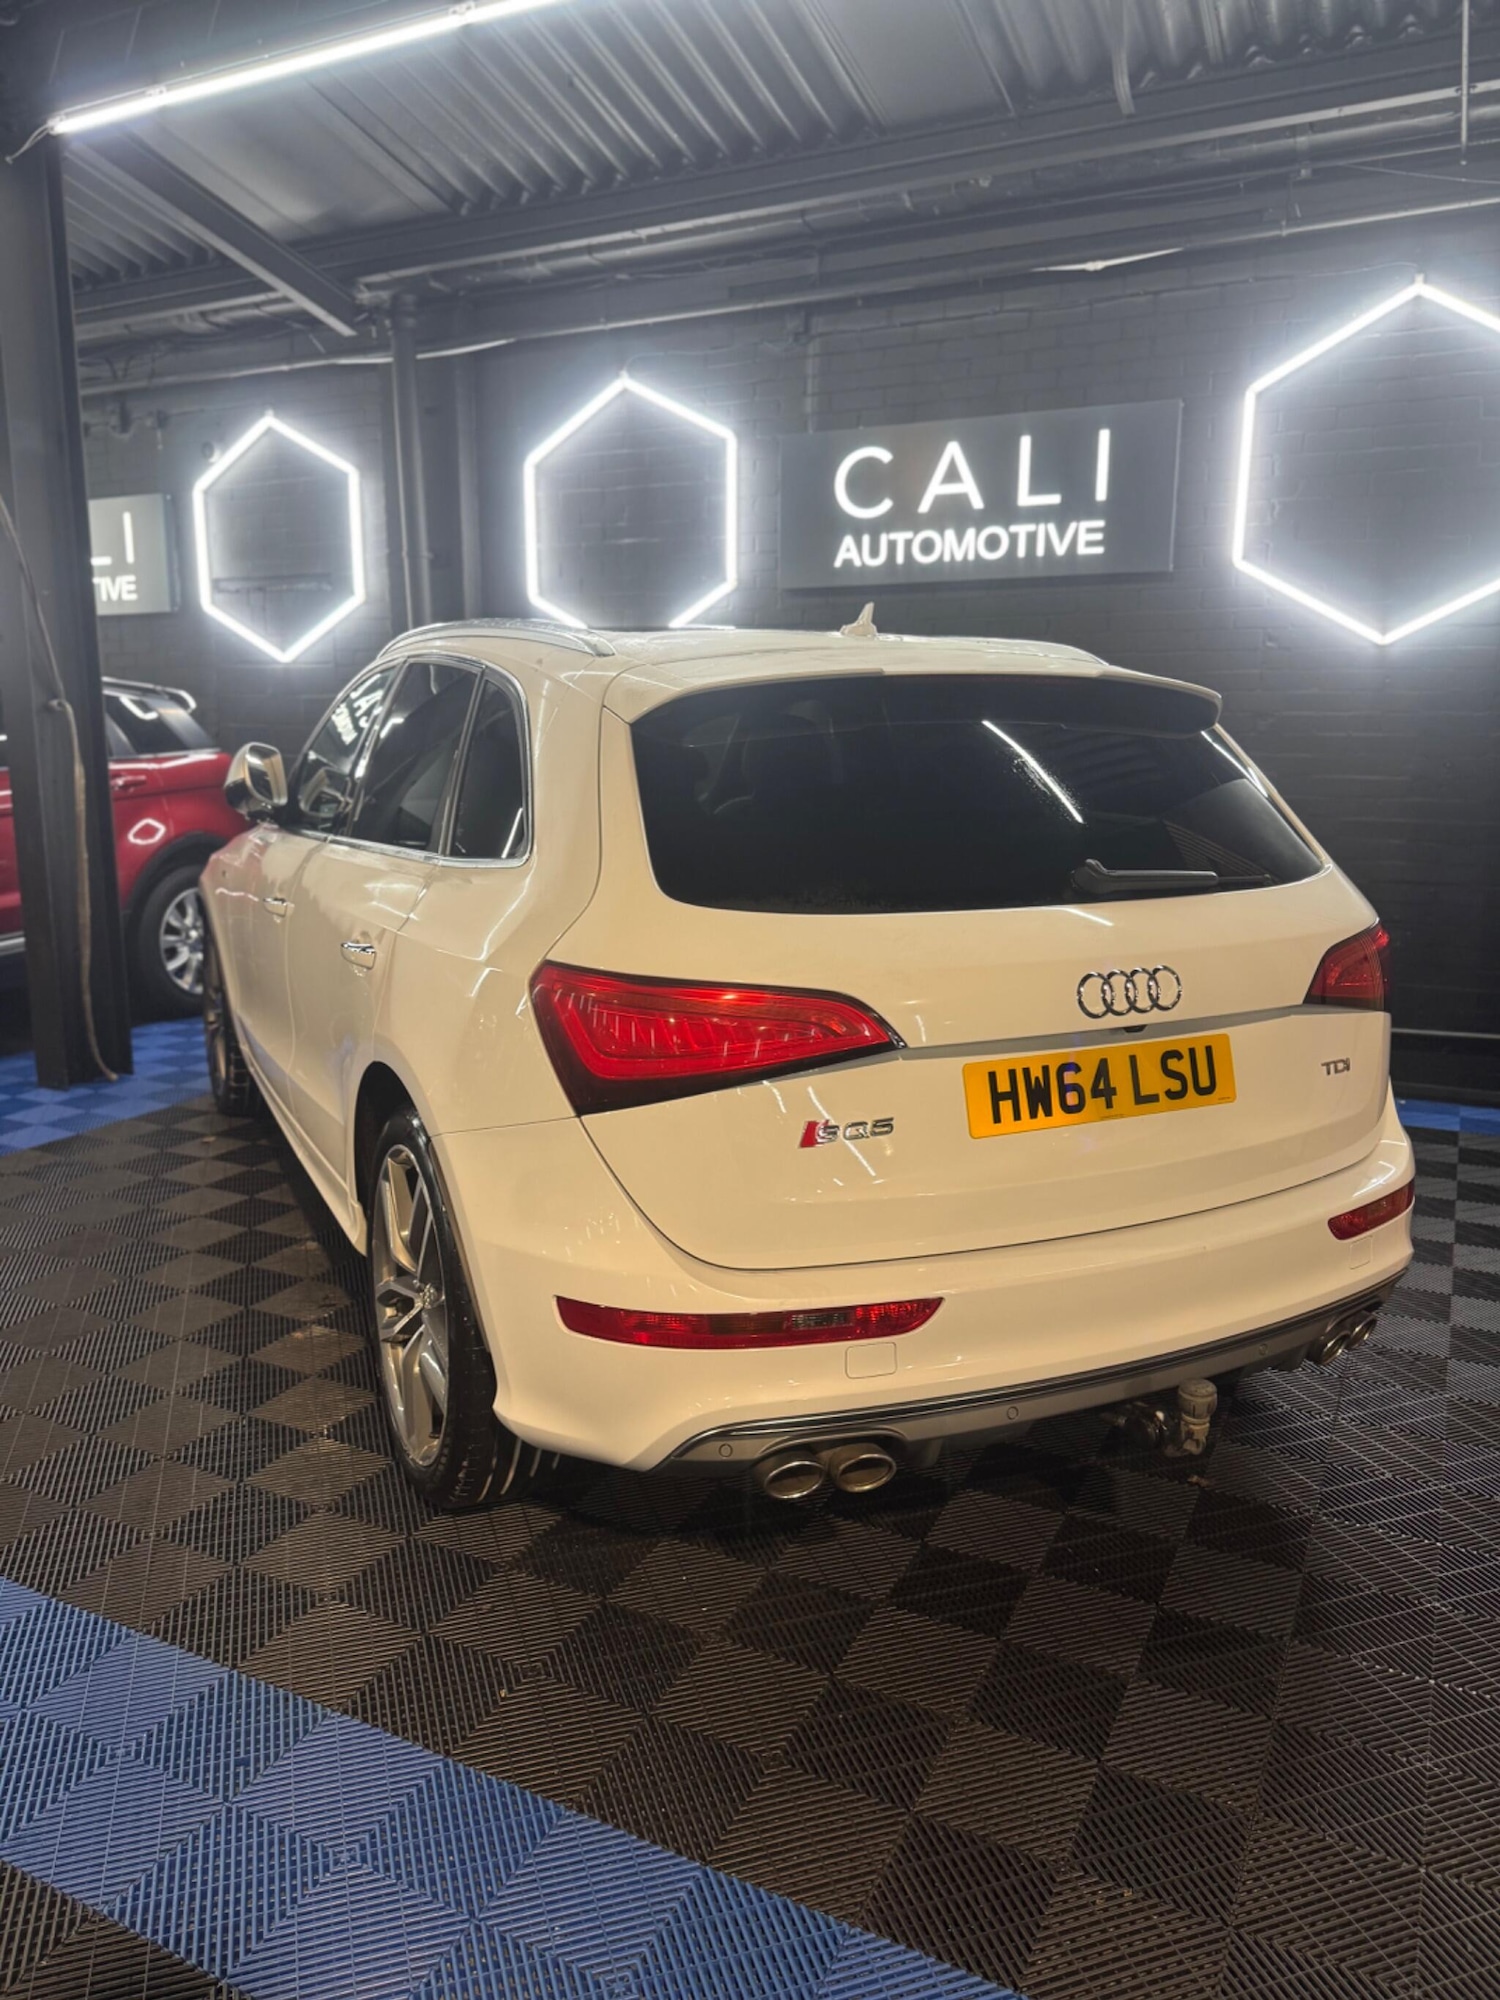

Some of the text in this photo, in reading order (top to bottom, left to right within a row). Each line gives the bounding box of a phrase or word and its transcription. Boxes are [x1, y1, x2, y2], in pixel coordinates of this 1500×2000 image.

[834, 428, 1111, 519] CALI
[834, 520, 1106, 568] AUTOMOTIVE
[987, 1045, 1217, 1124] HW64 LSU
[815, 1117, 894, 1145] SQ5
